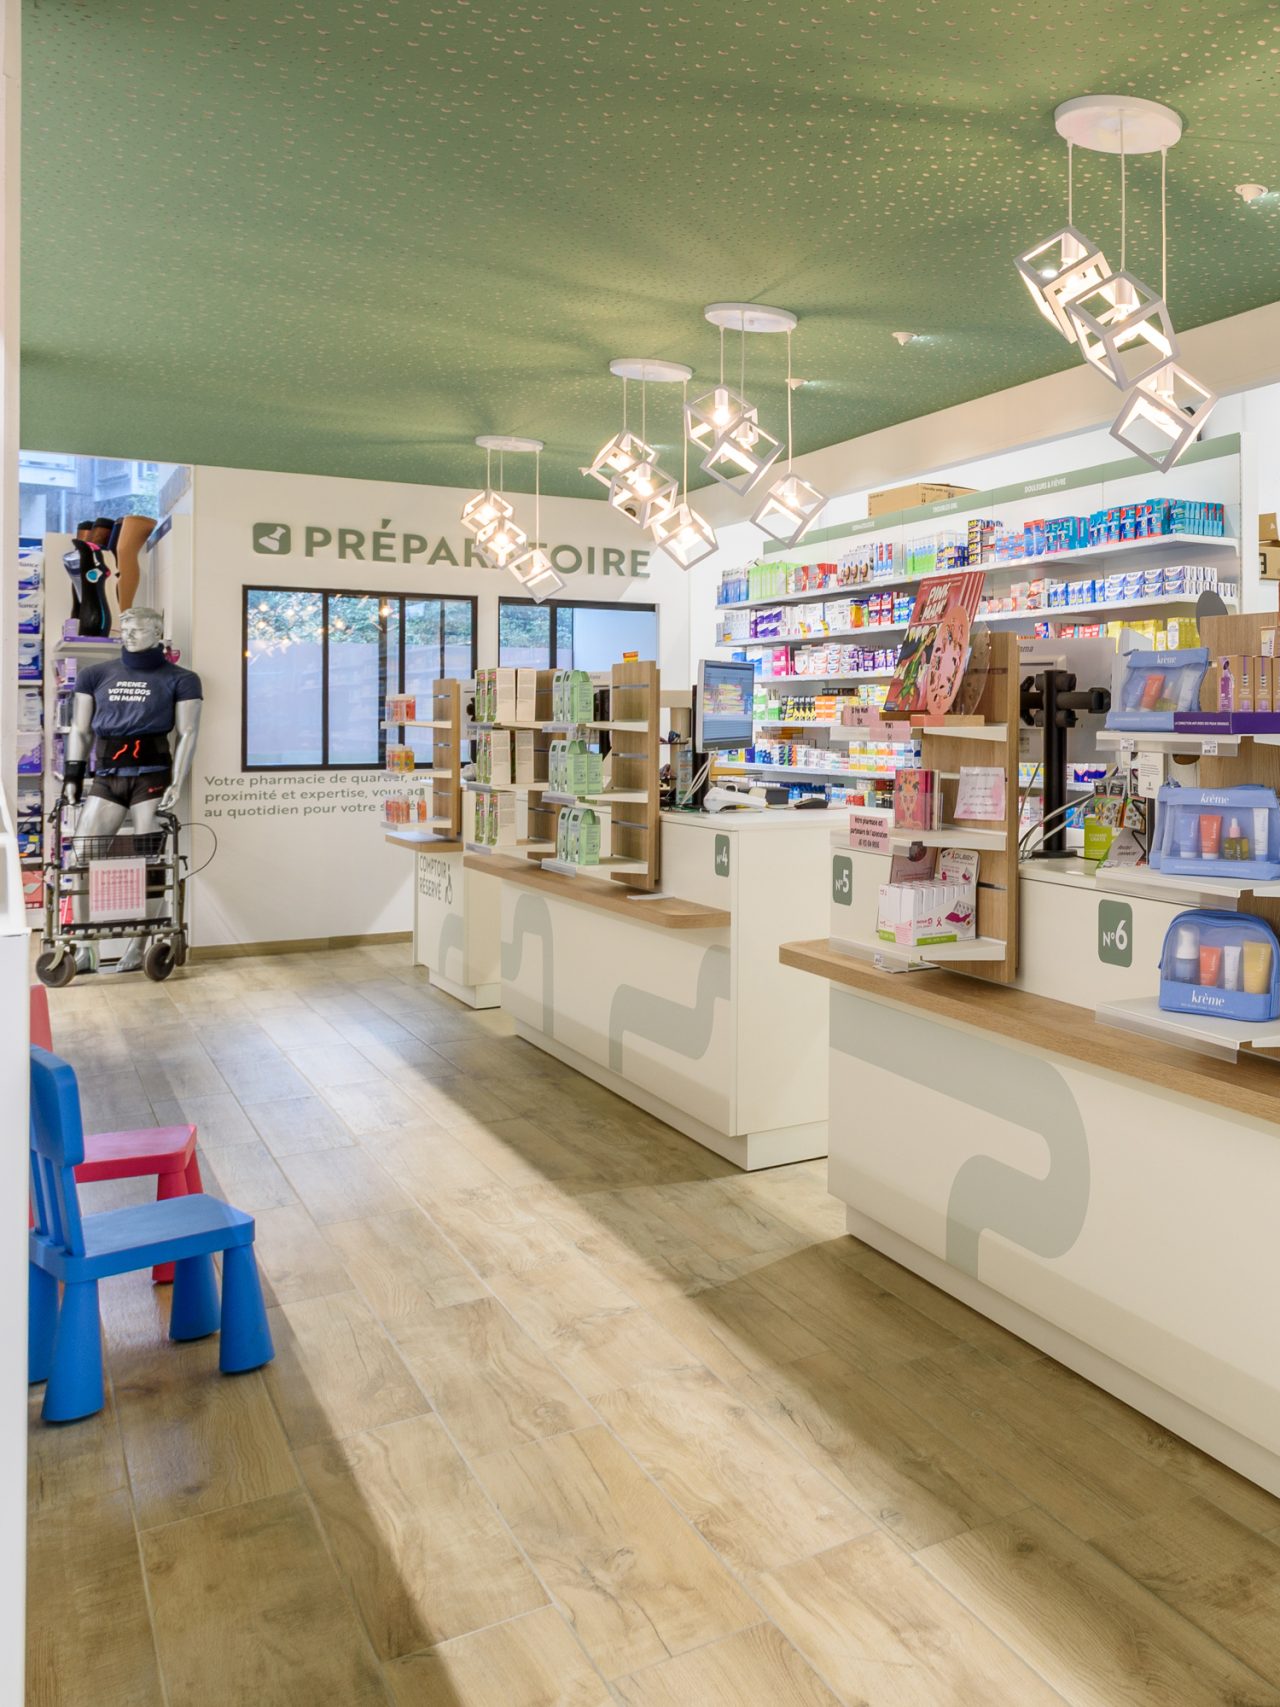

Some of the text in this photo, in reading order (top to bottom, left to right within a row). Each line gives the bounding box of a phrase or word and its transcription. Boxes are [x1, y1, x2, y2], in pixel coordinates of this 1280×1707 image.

[135, 688, 151, 696] DOS
[204, 776, 245, 786] Votre
[249, 774, 326, 788] pharmacie
[329, 773, 347, 784] de
[204, 790, 278, 804] proximité
[281, 790, 296, 800] et
[300, 788, 368, 803] expertise,
[1200, 793, 1230, 805] krème
[204, 808, 222, 818] au
[227, 805, 299, 819] quotidien
[303, 804, 337, 816] pour
[340, 803, 376, 813] votre
[1191, 990, 1225, 1007] krème
